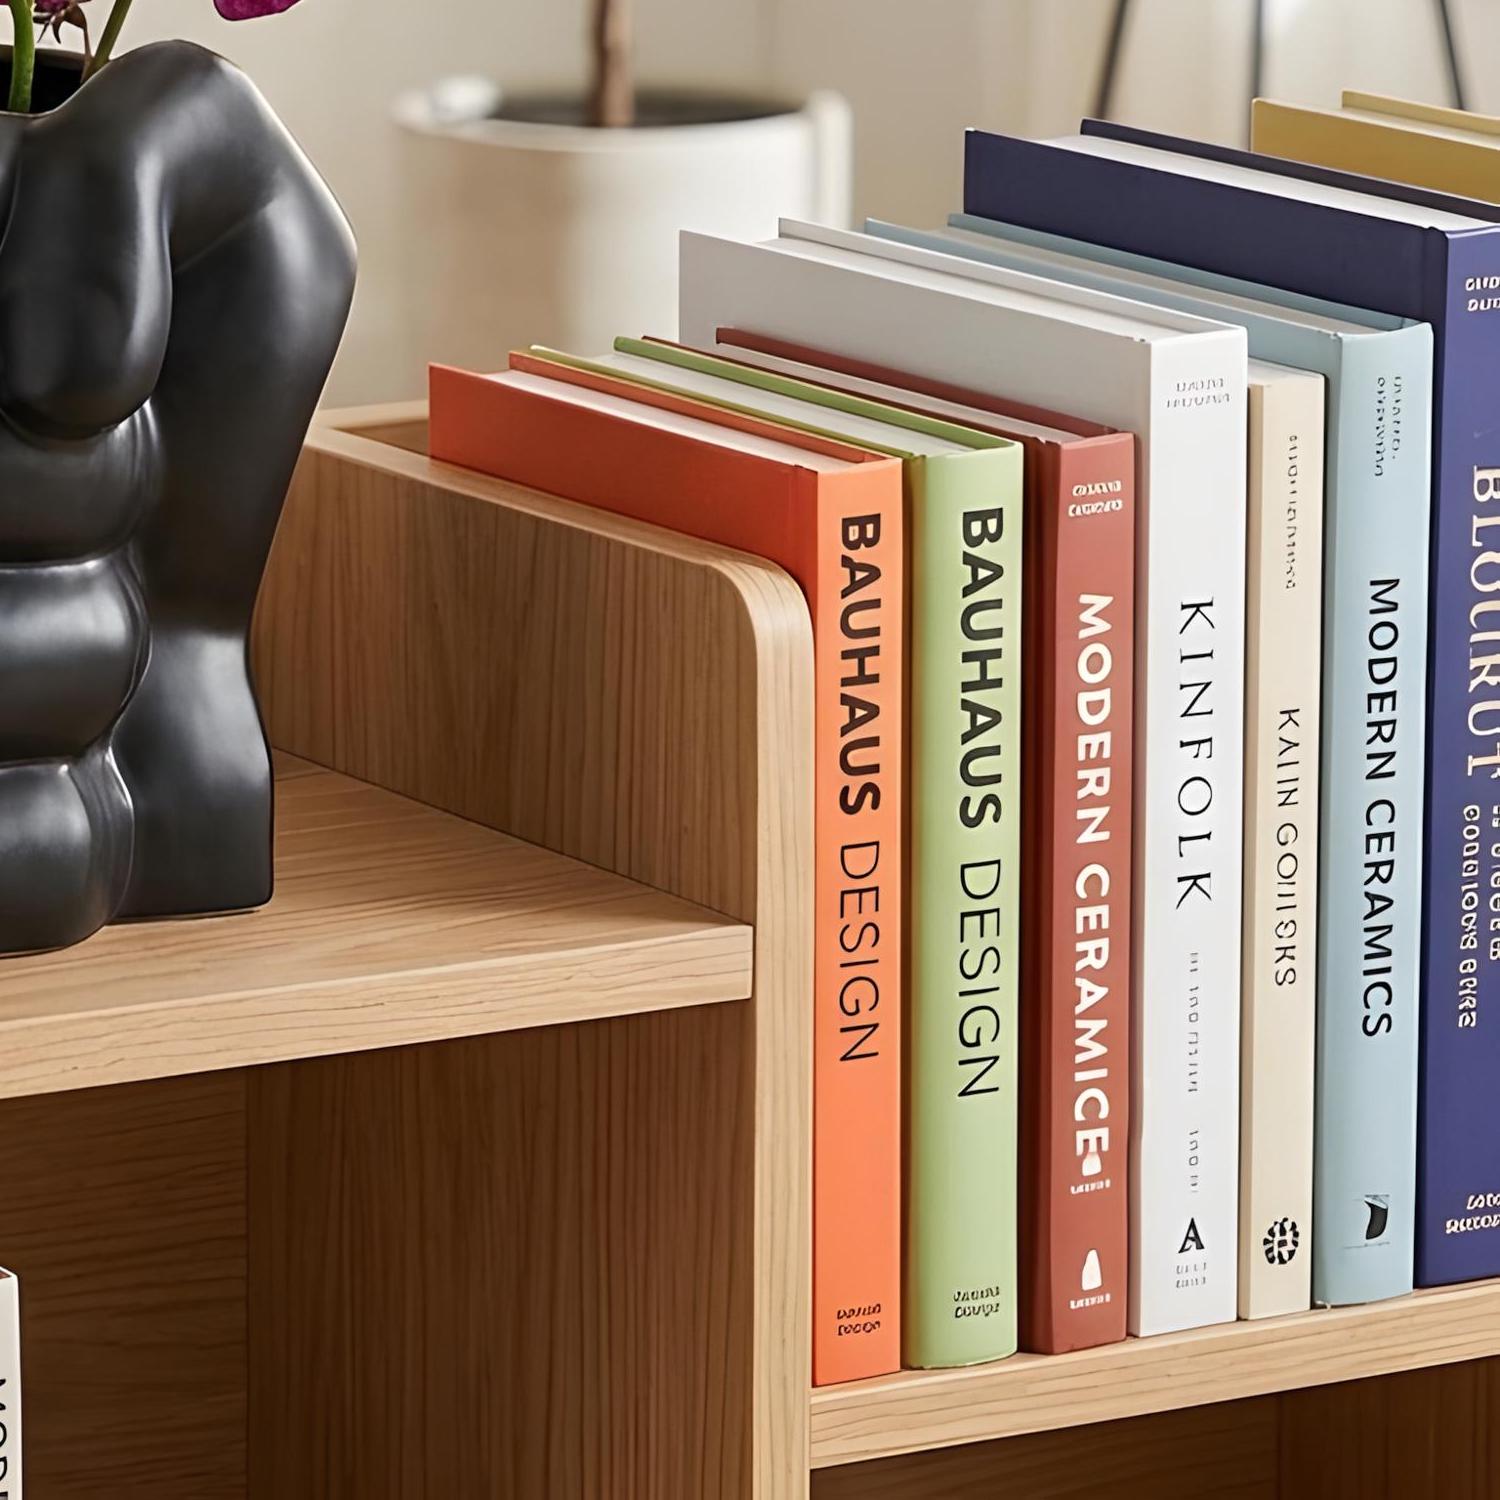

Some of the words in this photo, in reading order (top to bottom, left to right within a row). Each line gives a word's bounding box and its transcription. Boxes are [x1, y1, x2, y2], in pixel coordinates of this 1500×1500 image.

[838, 512, 882, 816] BAUHAUS
[959, 506, 1005, 829] BAUHAUS
[1073, 593, 1115, 846] MODERN
[1176, 595, 1216, 910] KINFOLK
[1365, 577, 1402, 782] MODERN
[839, 839, 880, 1063] DESIGN
[957, 858, 1002, 1099] DESIGN
[1360, 797, 1397, 1038] CERAMICS
